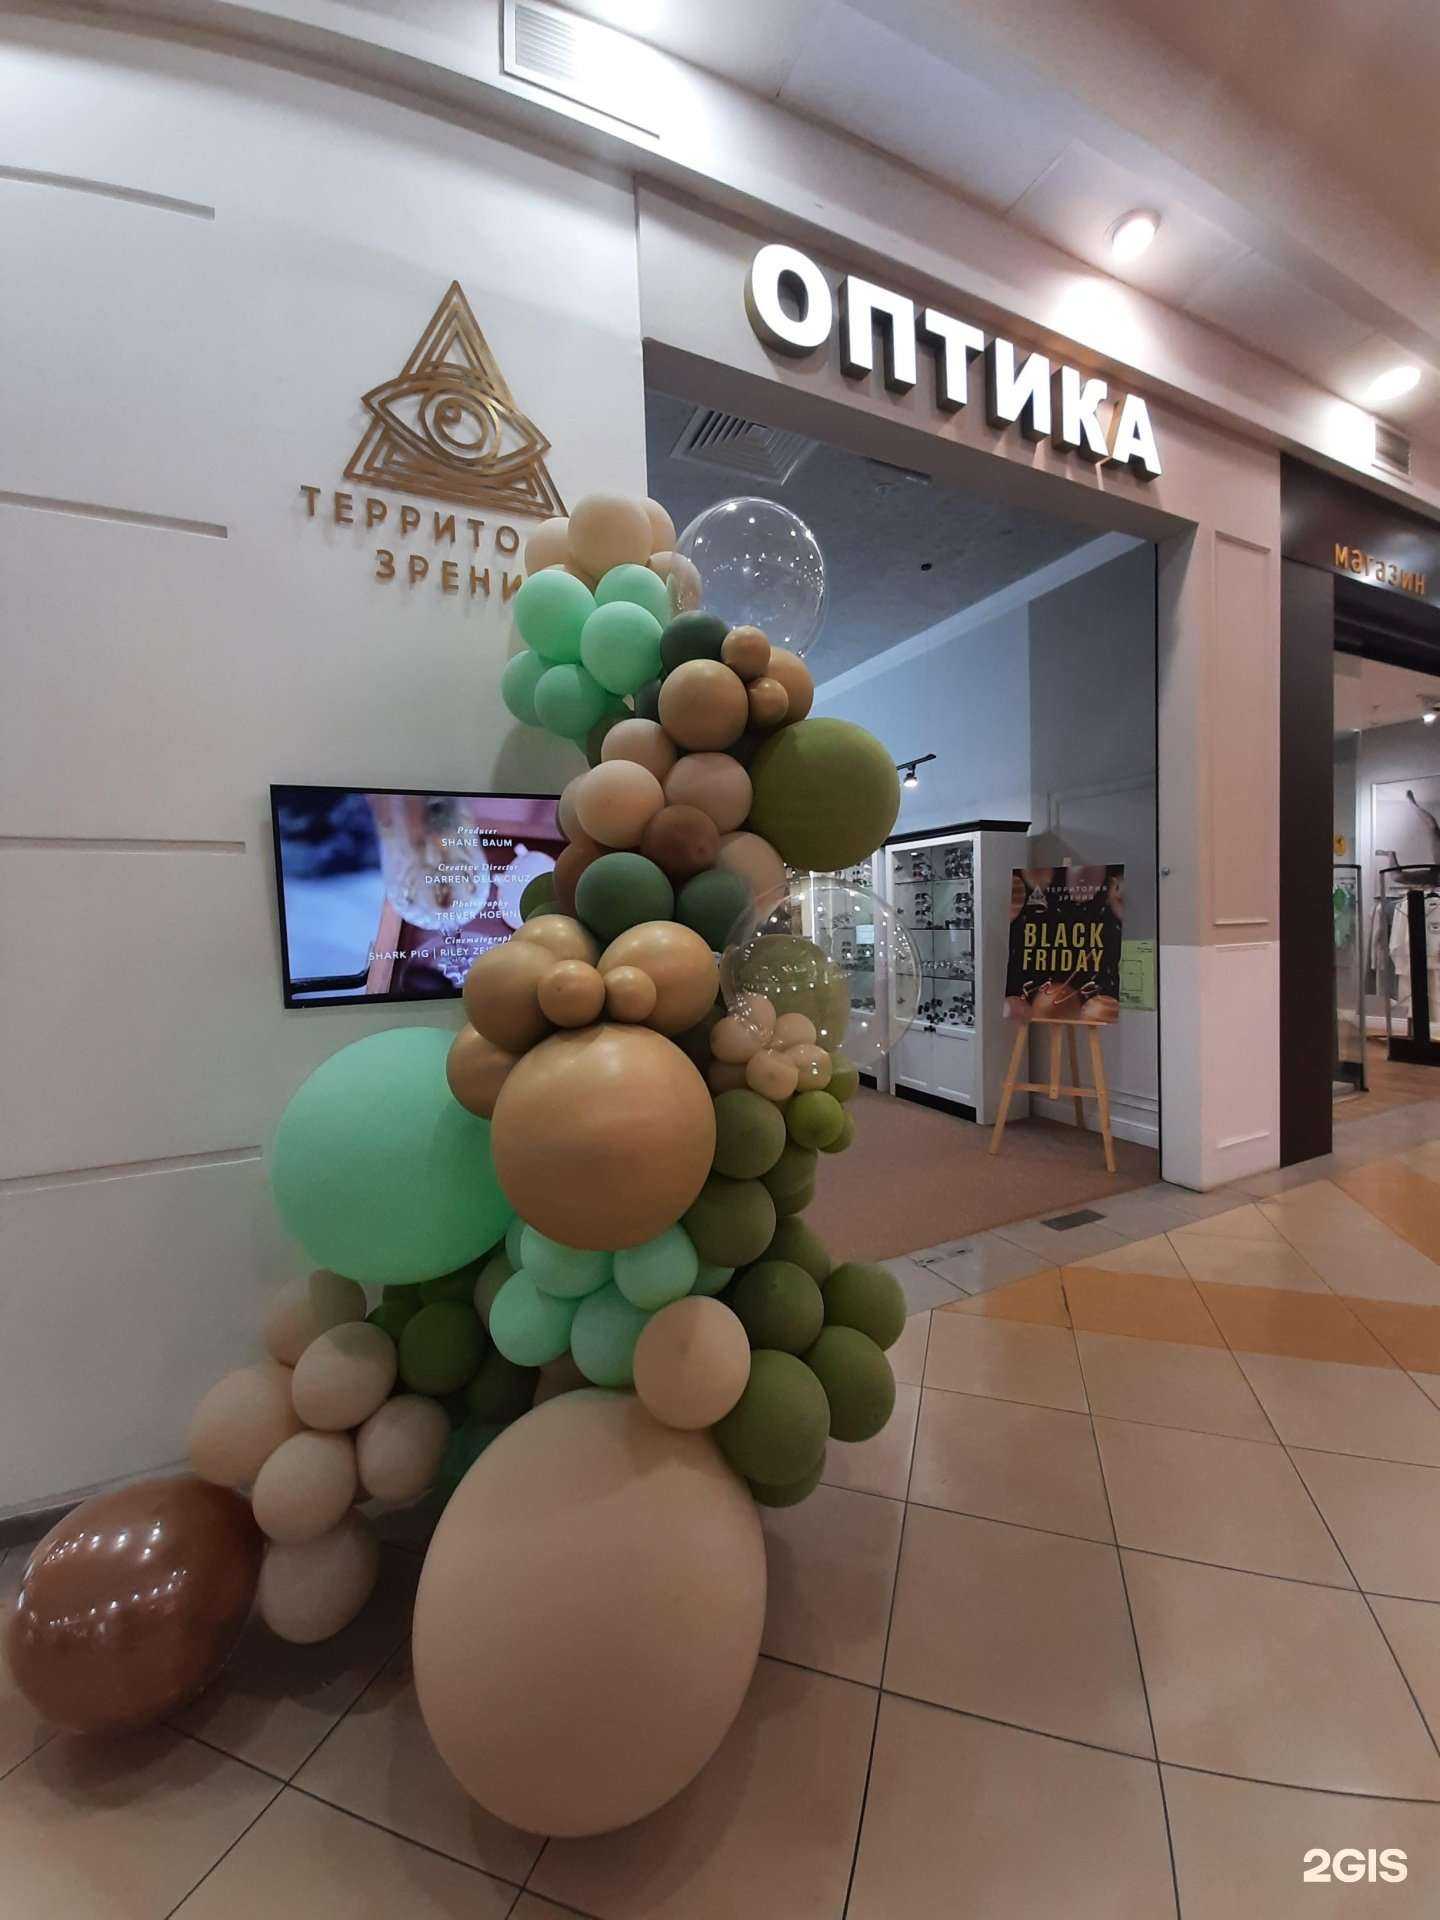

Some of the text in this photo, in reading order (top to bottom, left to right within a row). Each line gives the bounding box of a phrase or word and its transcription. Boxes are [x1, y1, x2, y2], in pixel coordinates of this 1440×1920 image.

[746, 244, 1162, 480] ОПТИКА
[300, 485, 521, 553] ТЕРРИТО
[375, 549, 523, 604] ЗРЕНИ
[457, 826, 498, 835] Producer
[440, 838, 513, 847] SHANE BAUM
[481, 863, 518, 871] Director
[425, 875, 469, 884] DARREN
[436, 910, 521, 920] TREVER HOEHN
[1024, 922, 1104, 948] BLACK
[369, 950, 407, 961] SHARK
[410, 949, 429, 959] PIG
[440, 947, 469, 957] RILEY
[1022, 949, 1104, 972] FRIDAY
